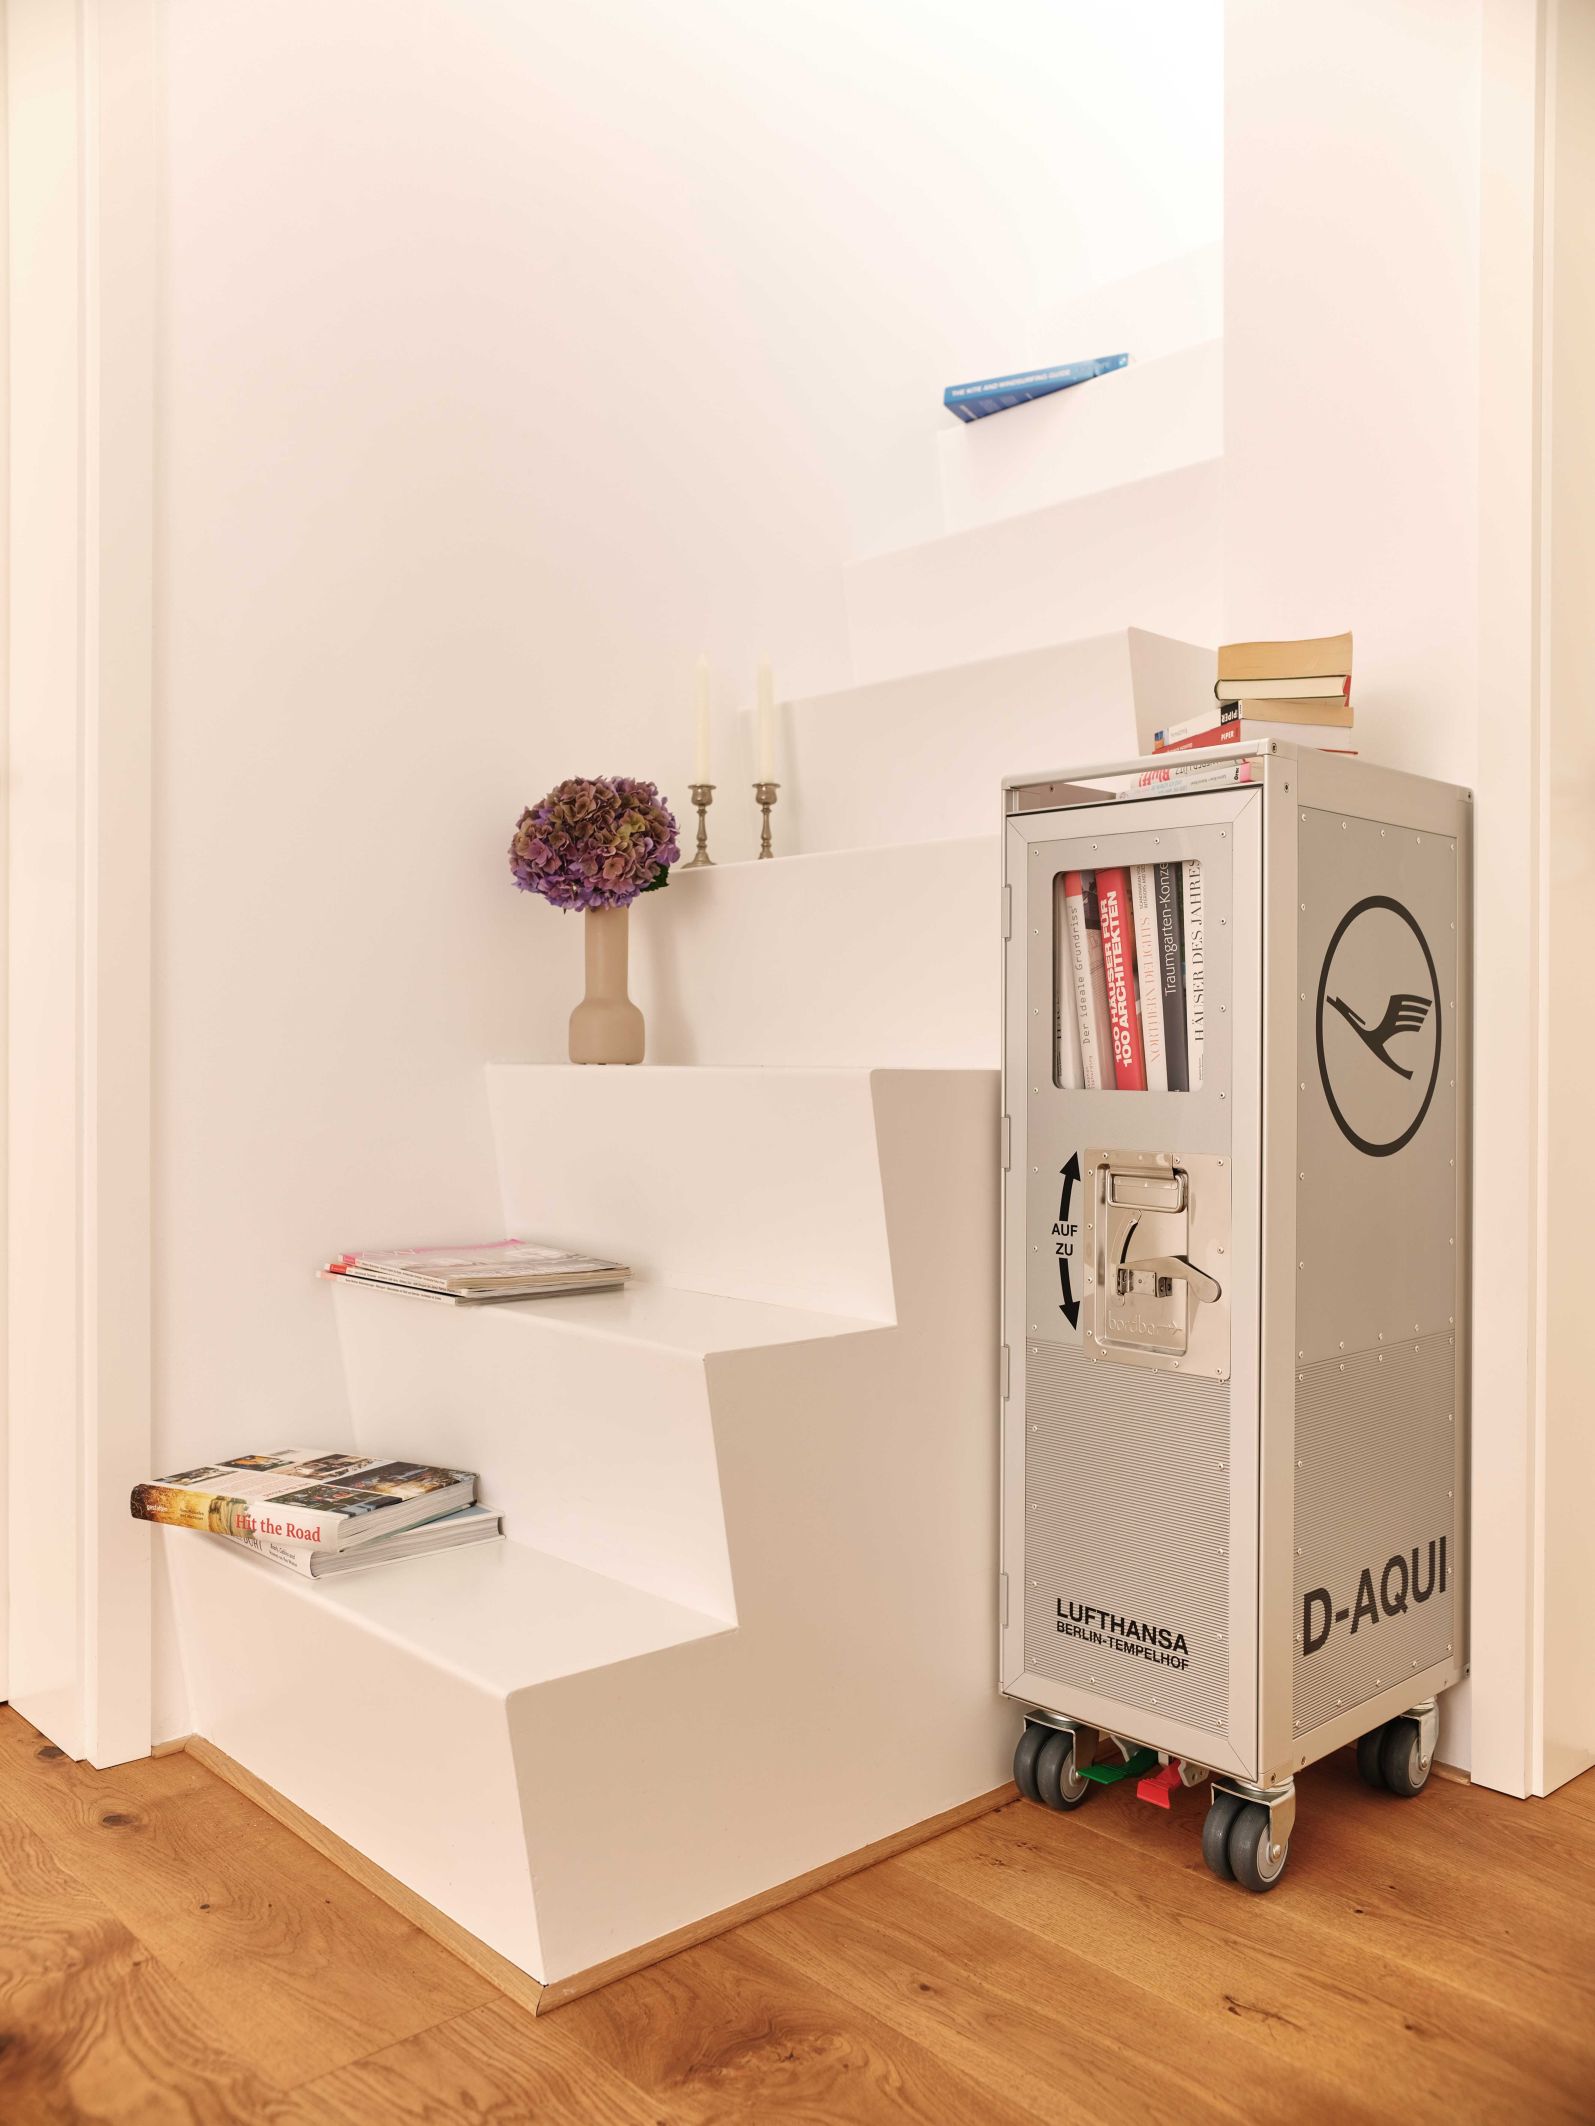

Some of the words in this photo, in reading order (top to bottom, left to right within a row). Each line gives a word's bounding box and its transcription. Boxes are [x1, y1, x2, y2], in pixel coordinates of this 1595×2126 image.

[952, 388, 965, 397] THE
[983, 383, 998, 391] AND
[1221, 709, 1237, 723] PIPER
[1221, 731, 1234, 741] PIPER
[1100, 899, 1110, 939] FÜR
[1107, 891, 1129, 1027] ARCHITEKTEN
[1141, 916, 1155, 984] DELIGHTS
[1191, 931, 1204, 964] DES
[1077, 977, 1088, 1016] ideale
[1104, 942, 1118, 1023] HÄUSER
[1192, 971, 1204, 1040] HÄUSER
[1082, 1024, 1090, 1044] Der
[1113, 1026, 1122, 1062] 100
[1147, 988, 1161, 1063] NORTHERN
[1121, 1030, 1132, 1067] 100
[1052, 1223, 1078, 1237] AUF
[1056, 1243, 1073, 1256] ZU
[236, 1512, 256, 1531] Hit
[260, 1518, 283, 1535] the
[286, 1524, 321, 1542] Road
[1303, 1536, 1446, 1656] D-AQUI
[1056, 1621, 1189, 1670] BERLIN-TEMPELHOF
[1057, 1598, 1188, 1655] LUFTHANSA
